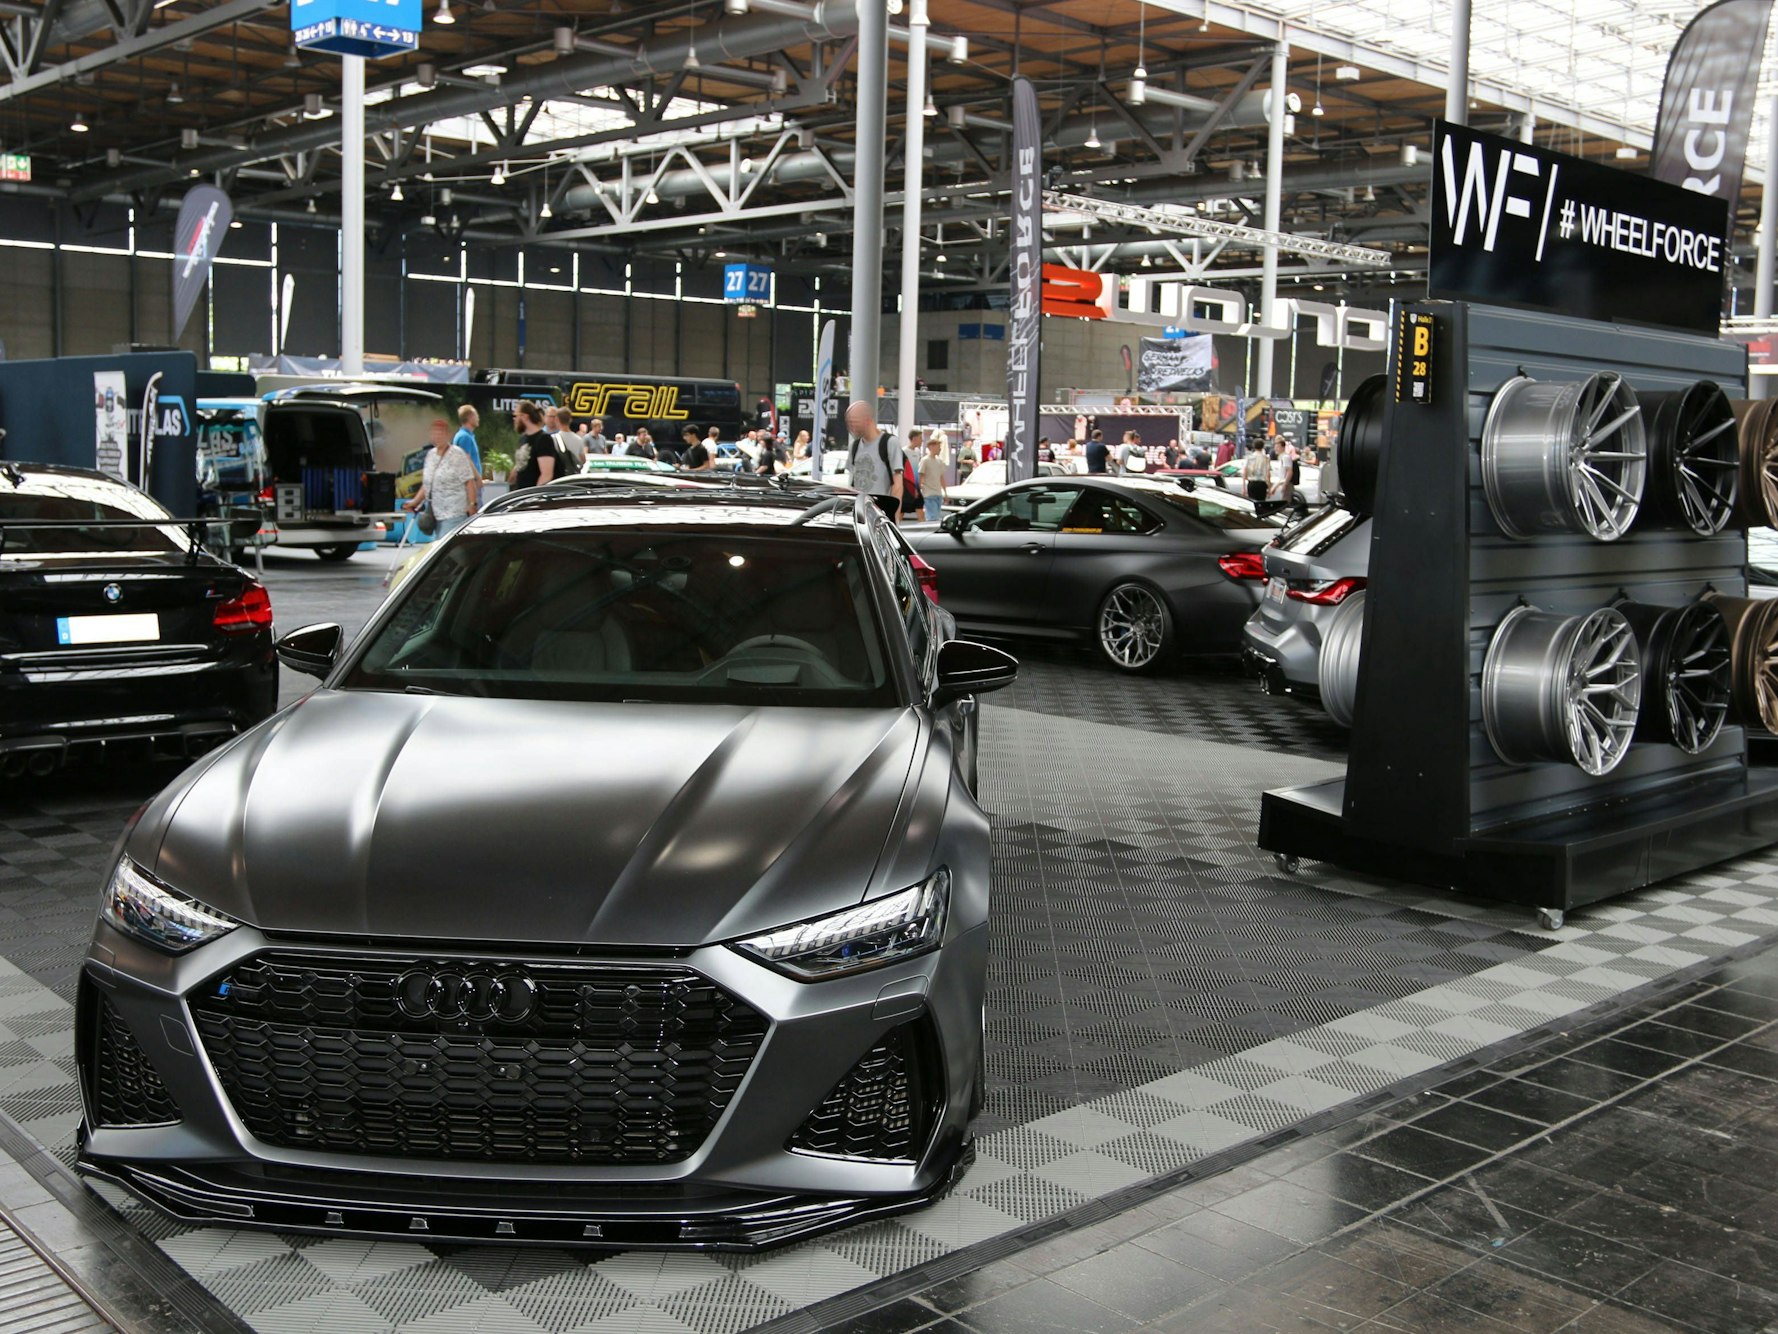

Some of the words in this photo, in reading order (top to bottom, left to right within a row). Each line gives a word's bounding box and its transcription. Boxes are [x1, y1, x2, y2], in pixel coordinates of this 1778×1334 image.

[726, 271, 744, 292] 27
[747, 271, 769, 293] 27
[1413, 326, 1430, 357] B
[1412, 361, 1427, 377] 28
